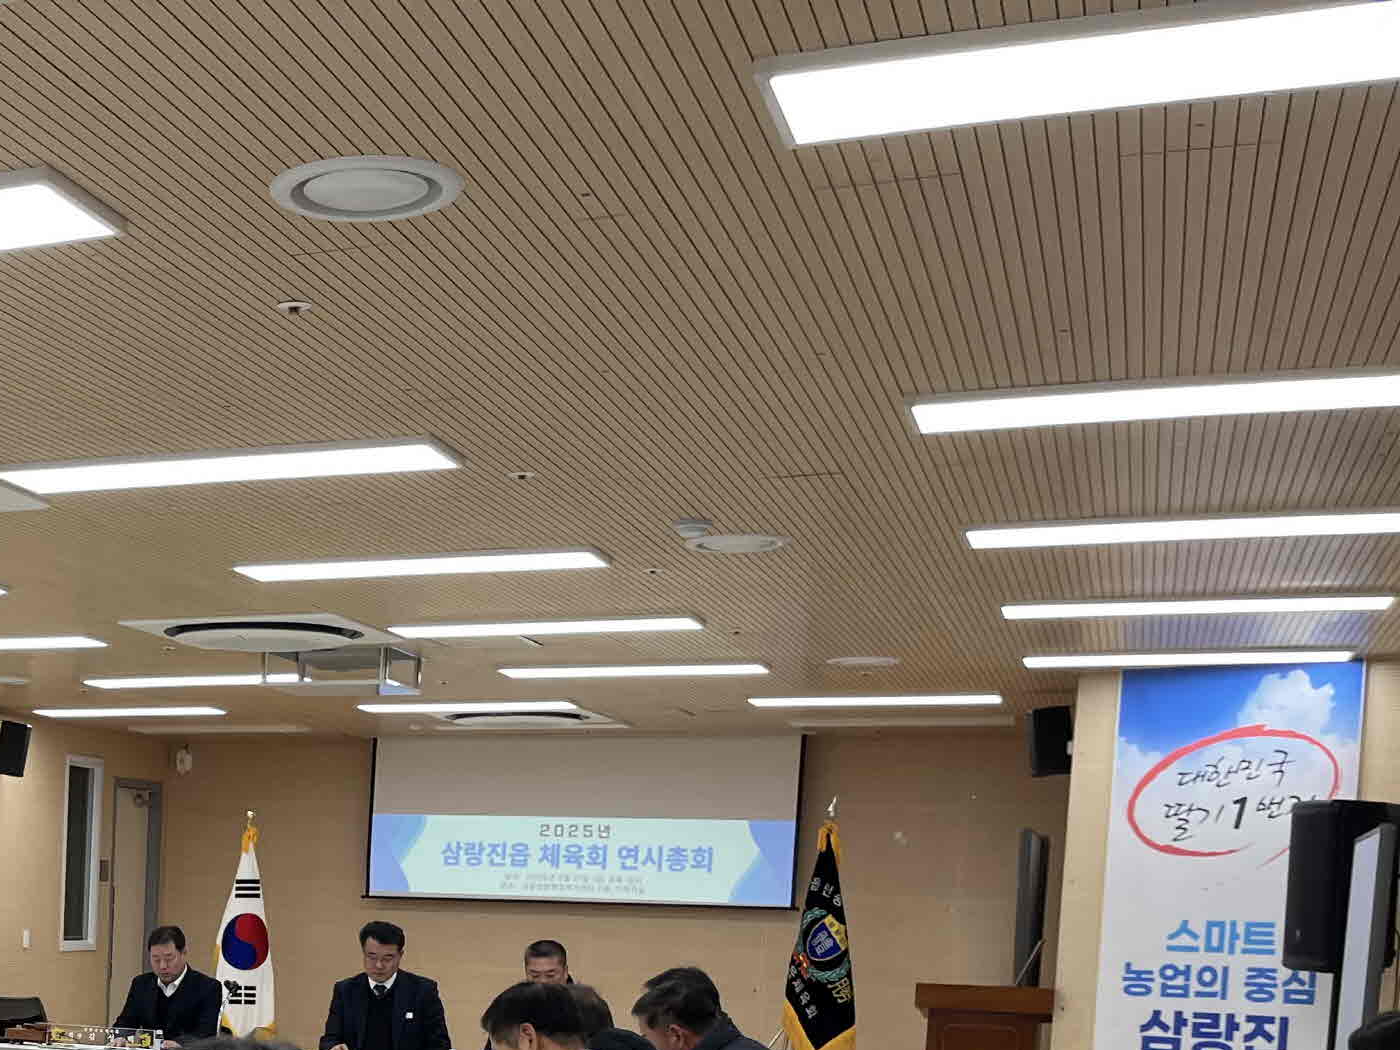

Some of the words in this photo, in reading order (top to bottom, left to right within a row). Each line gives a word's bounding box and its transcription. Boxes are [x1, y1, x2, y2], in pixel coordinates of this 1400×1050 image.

[1176, 748, 1296, 788] 대한민국
[539, 823, 612, 839] 2025년
[1163, 800, 1226, 842] 딸기
[440, 841, 532, 868] 삼랑진읍
[538, 843, 609, 870] 체육회
[617, 845, 714, 873] 연시총회
[1166, 920, 1277, 956] 스마트
[1121, 962, 1229, 1001] 농업의
[1243, 968, 1318, 1005] 중심
